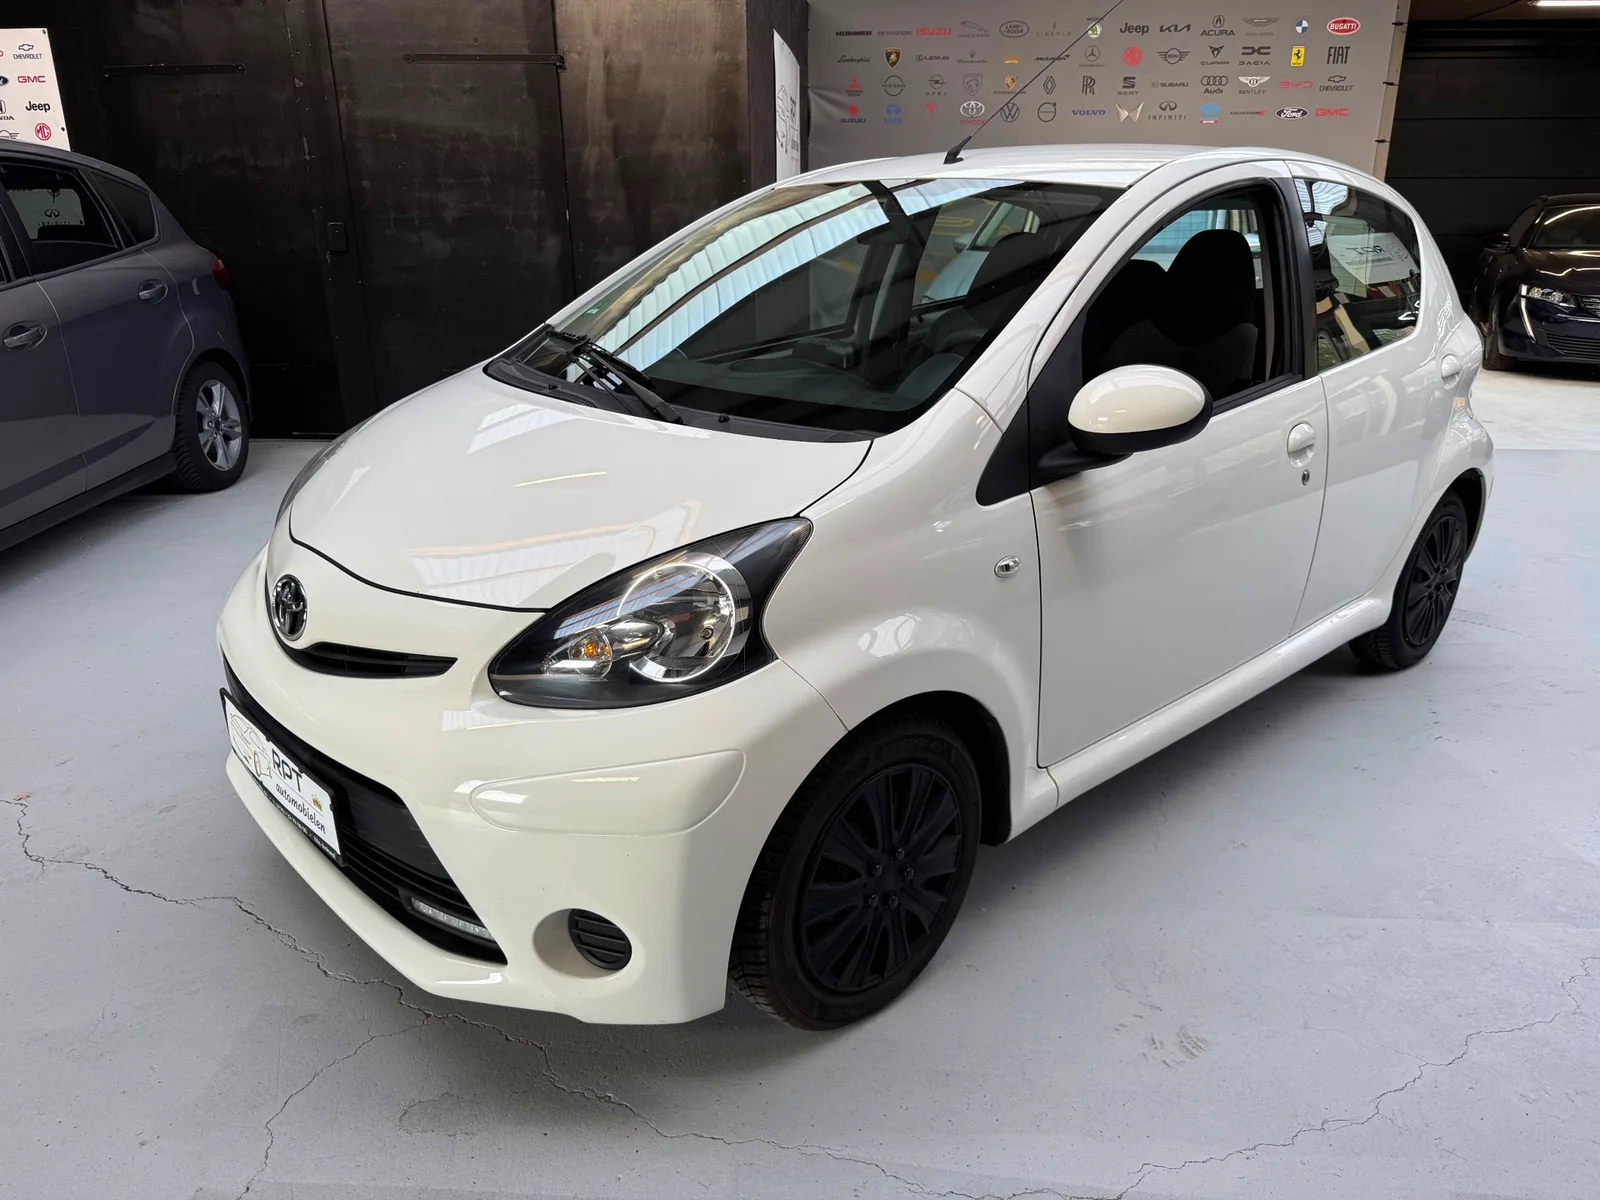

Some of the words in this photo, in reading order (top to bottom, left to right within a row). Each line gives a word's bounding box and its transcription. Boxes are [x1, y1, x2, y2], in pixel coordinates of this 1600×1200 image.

[916, 28, 951, 36] ISUZU
[1120, 22, 1150, 36] Jeep
[1160, 24, 1191, 32] KIA
[1326, 46, 1350, 64] FIAT
[26, 101, 50, 112] Jeep
[1280, 108, 1304, 118] Ford
[272, 748, 302, 792] RPT
[275, 783, 326, 834] automobielen
